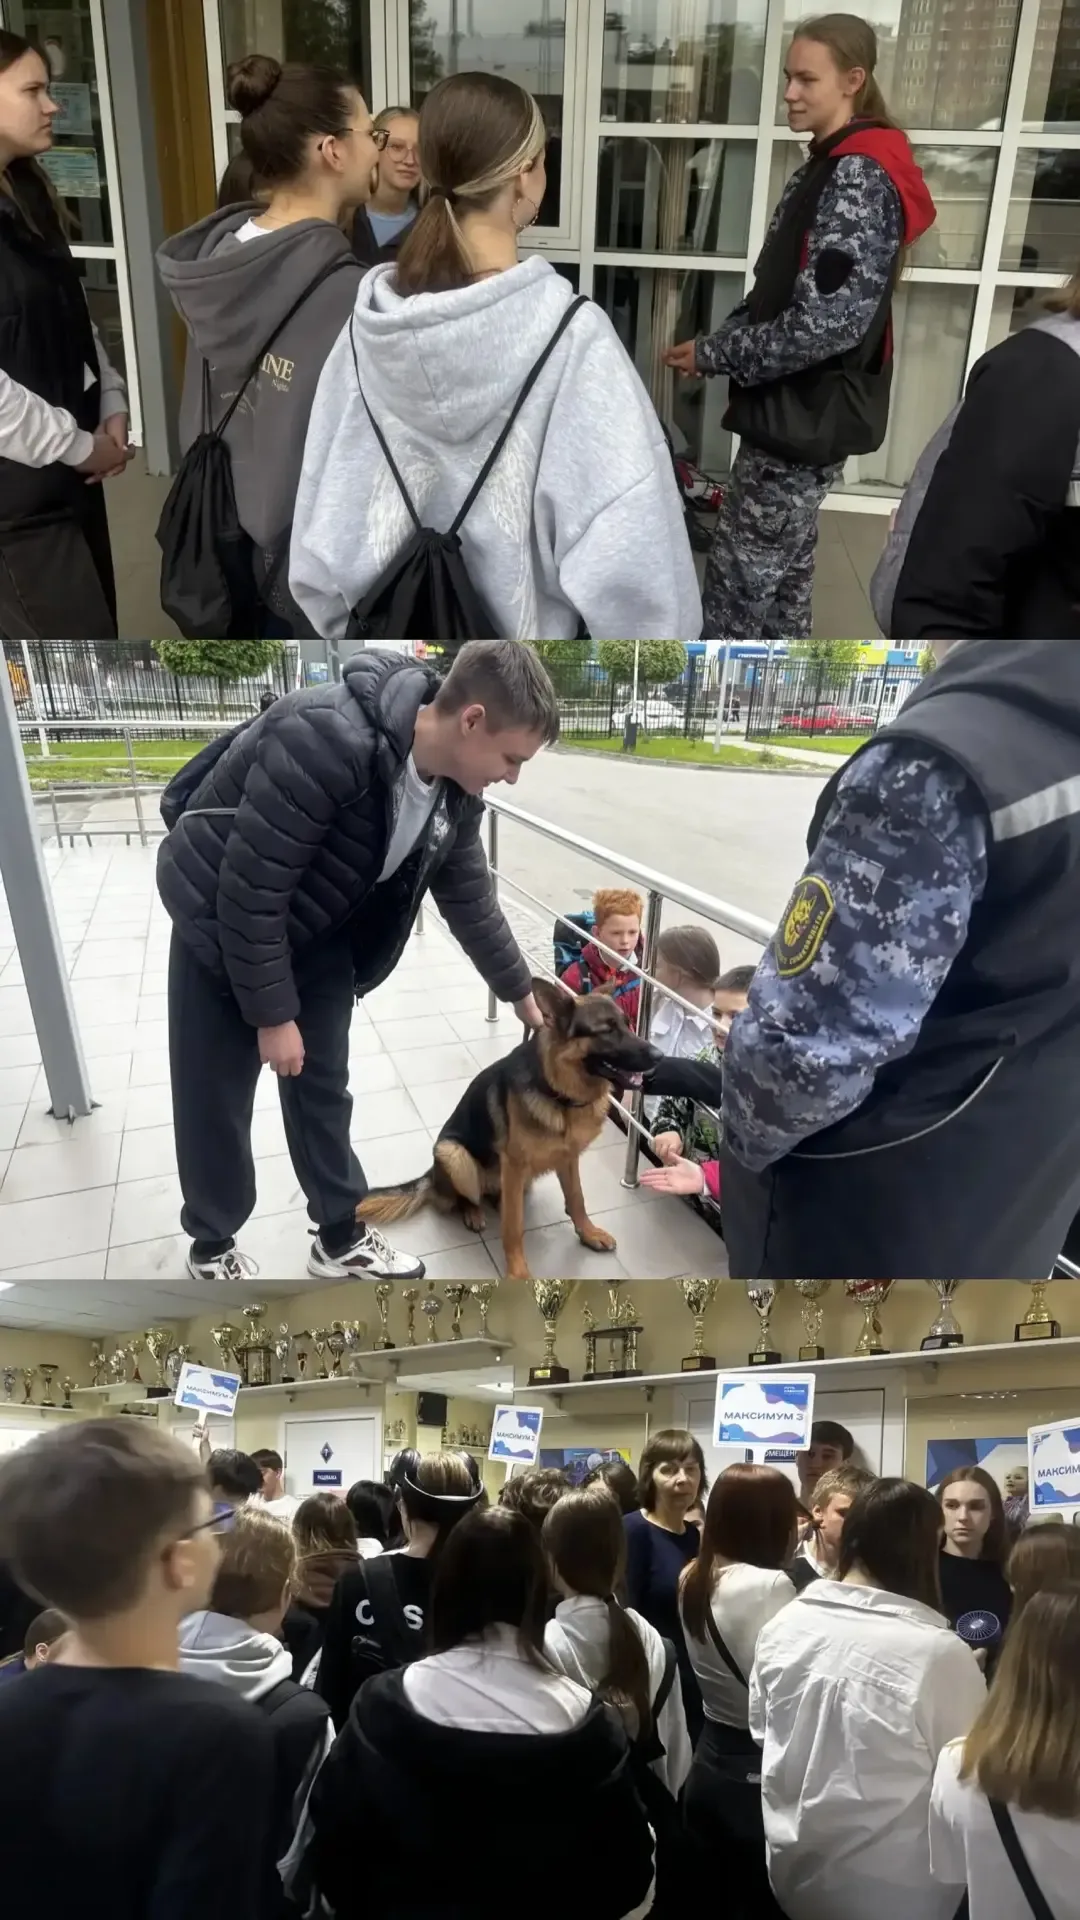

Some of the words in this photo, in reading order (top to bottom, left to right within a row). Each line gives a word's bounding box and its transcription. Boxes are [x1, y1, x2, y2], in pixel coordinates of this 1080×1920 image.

[723, 1412, 794, 1421] МАКСИМУМ
[796, 1413, 804, 1421] 3
[496, 1431, 530, 1441] МАКСИМУМ
[764, 1449, 797, 1458] ОМЕЩЕН
